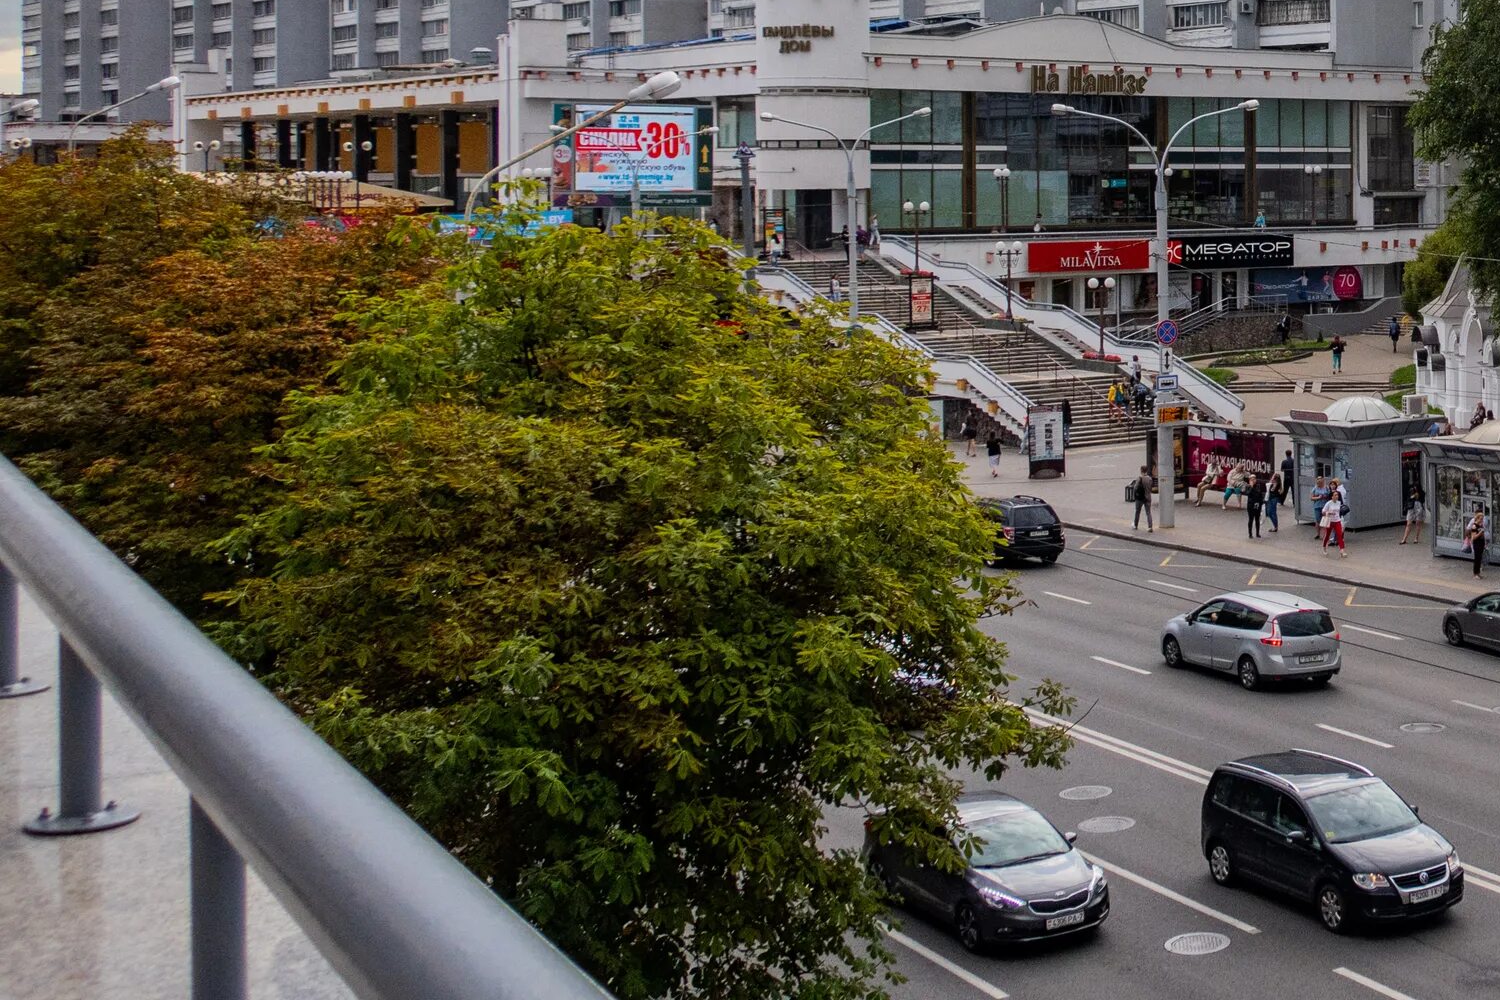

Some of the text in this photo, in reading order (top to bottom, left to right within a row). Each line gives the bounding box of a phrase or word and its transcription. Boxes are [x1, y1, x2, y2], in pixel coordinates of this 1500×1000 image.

[779, 40, 811, 54] ДОМ
[1186, 242, 1291, 255] MEGATOP
[1339, 273, 1356, 287] 70
